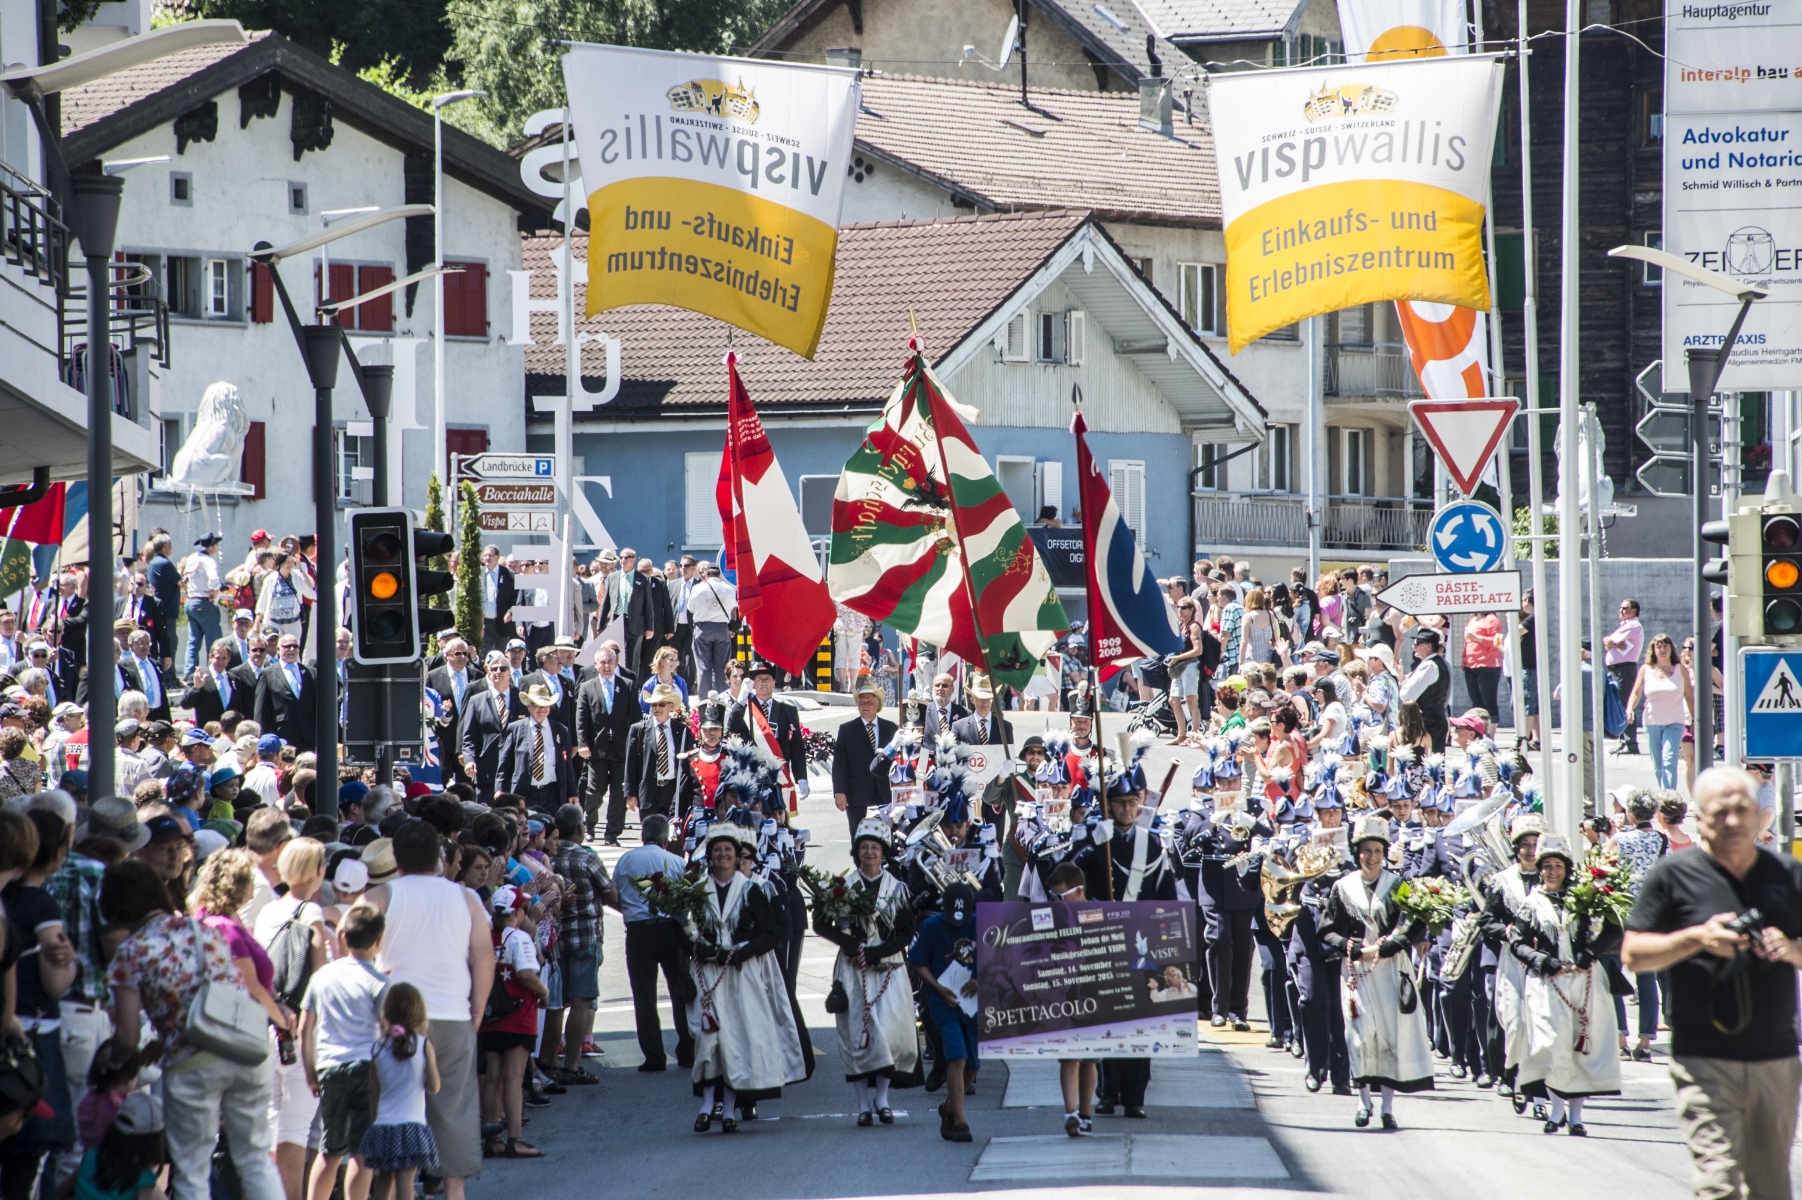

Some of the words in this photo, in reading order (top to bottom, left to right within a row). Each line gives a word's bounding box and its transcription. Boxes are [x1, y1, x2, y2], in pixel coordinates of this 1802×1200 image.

[1682, 4, 1771, 20] Hauptagentur
[1681, 66, 1751, 83] interalp
[1757, 65, 1788, 80] bau
[1261, 130, 1297, 143] SCHWEIZ
[1305, 124, 1333, 135] SUISSE
[1341, 120, 1396, 131] SWITZERLAND
[1682, 126, 1789, 145] Advokatur
[1682, 152, 1720, 170] und
[1682, 180, 1719, 191] Schmid
[1722, 178, 1761, 190] Willisch
[1764, 179, 1772, 188] &
[1262, 208, 1380, 257] Einkaufs-
[1391, 210, 1437, 232] und
[1250, 245, 1456, 303] Erlebniszentrum
[1683, 334, 1767, 346] ARZTPAXIS
[482, 460, 532, 473] Landbrücke
[484, 486, 554, 501] Bocciahalle
[482, 514, 506, 529] Vispa
[1435, 580, 1484, 594] GÄSTE-
[1436, 592, 1513, 606] PARKPLATZ
[1098, 637, 1121, 648] 1909
[1098, 647, 1122, 659] 2009
[1150, 946, 1180, 959] VISPE
[1098, 971, 1114, 981] 2015
[984, 997, 1098, 1034] SPETTACOLO
